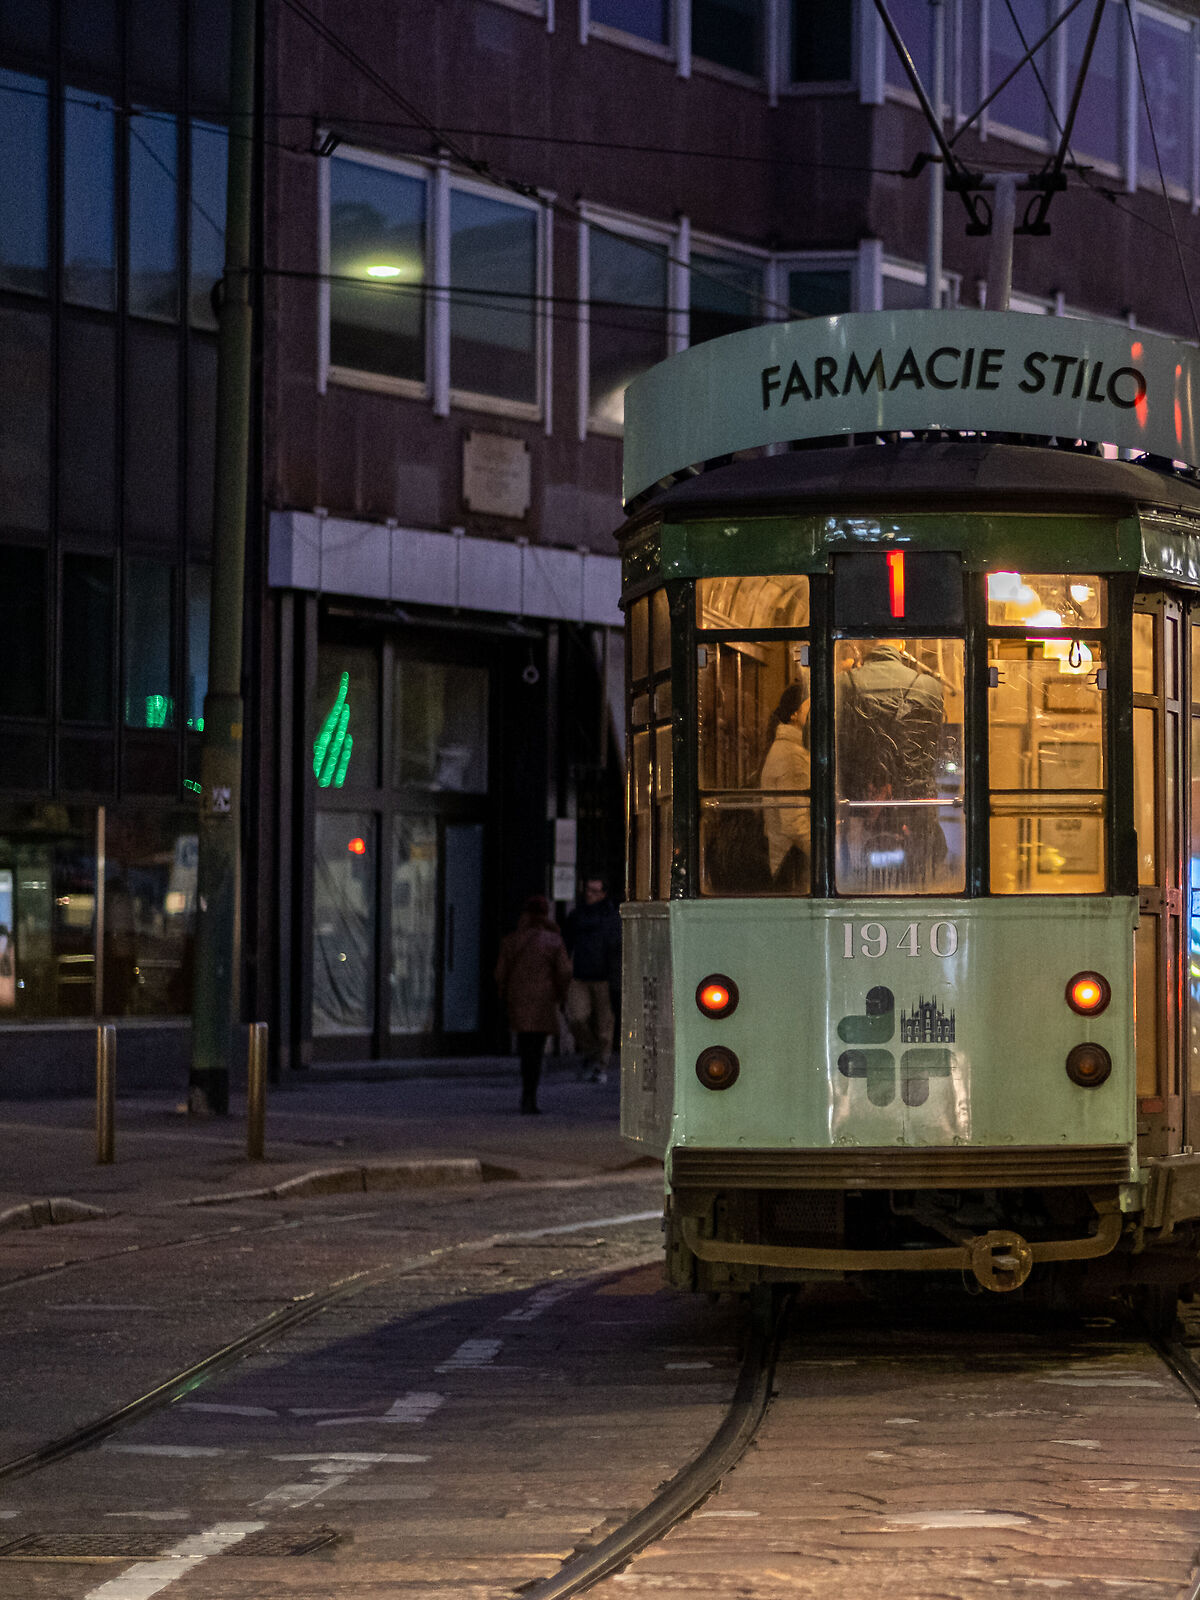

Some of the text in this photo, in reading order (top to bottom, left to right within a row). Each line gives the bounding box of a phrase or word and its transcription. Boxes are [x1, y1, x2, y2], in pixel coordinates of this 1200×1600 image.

[761, 346, 1147, 411] FARMACIE STILO
[886, 549, 905, 618] 1
[843, 921, 959, 959] 1940
